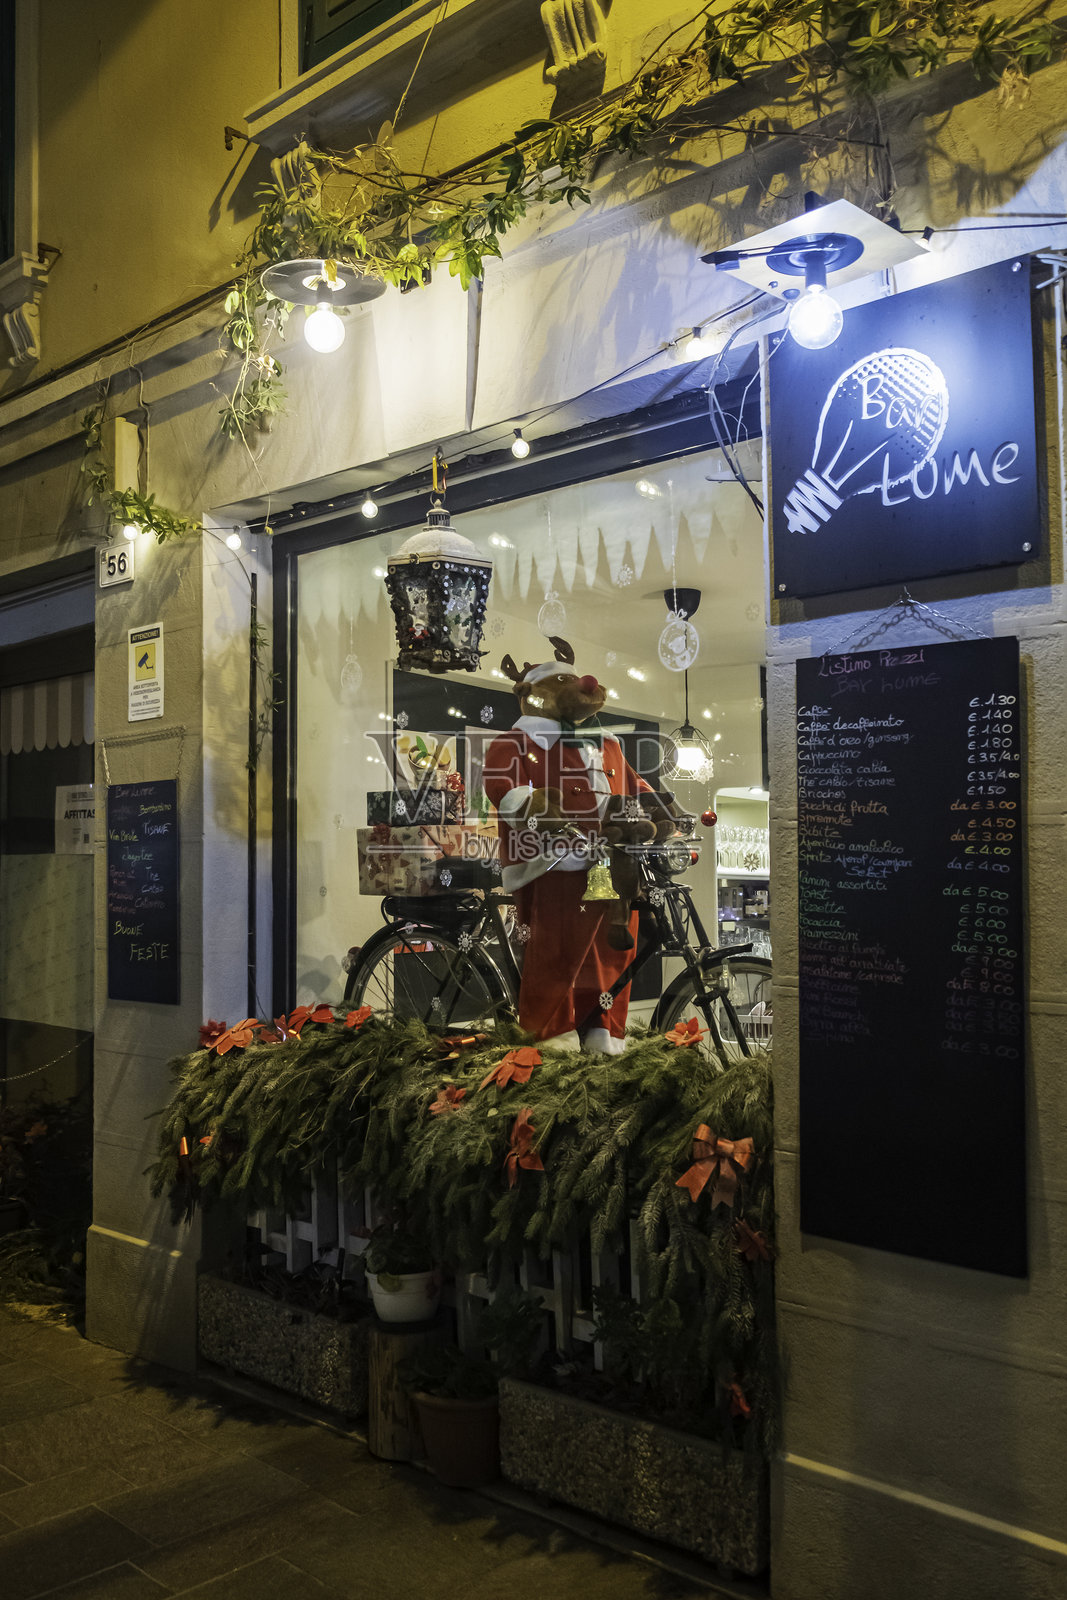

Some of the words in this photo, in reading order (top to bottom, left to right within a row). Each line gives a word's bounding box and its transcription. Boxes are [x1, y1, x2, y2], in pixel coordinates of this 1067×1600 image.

[861, 374, 939, 429] Bar
[107, 551, 128, 576] 56
[129, 943, 169, 960] FESTE
